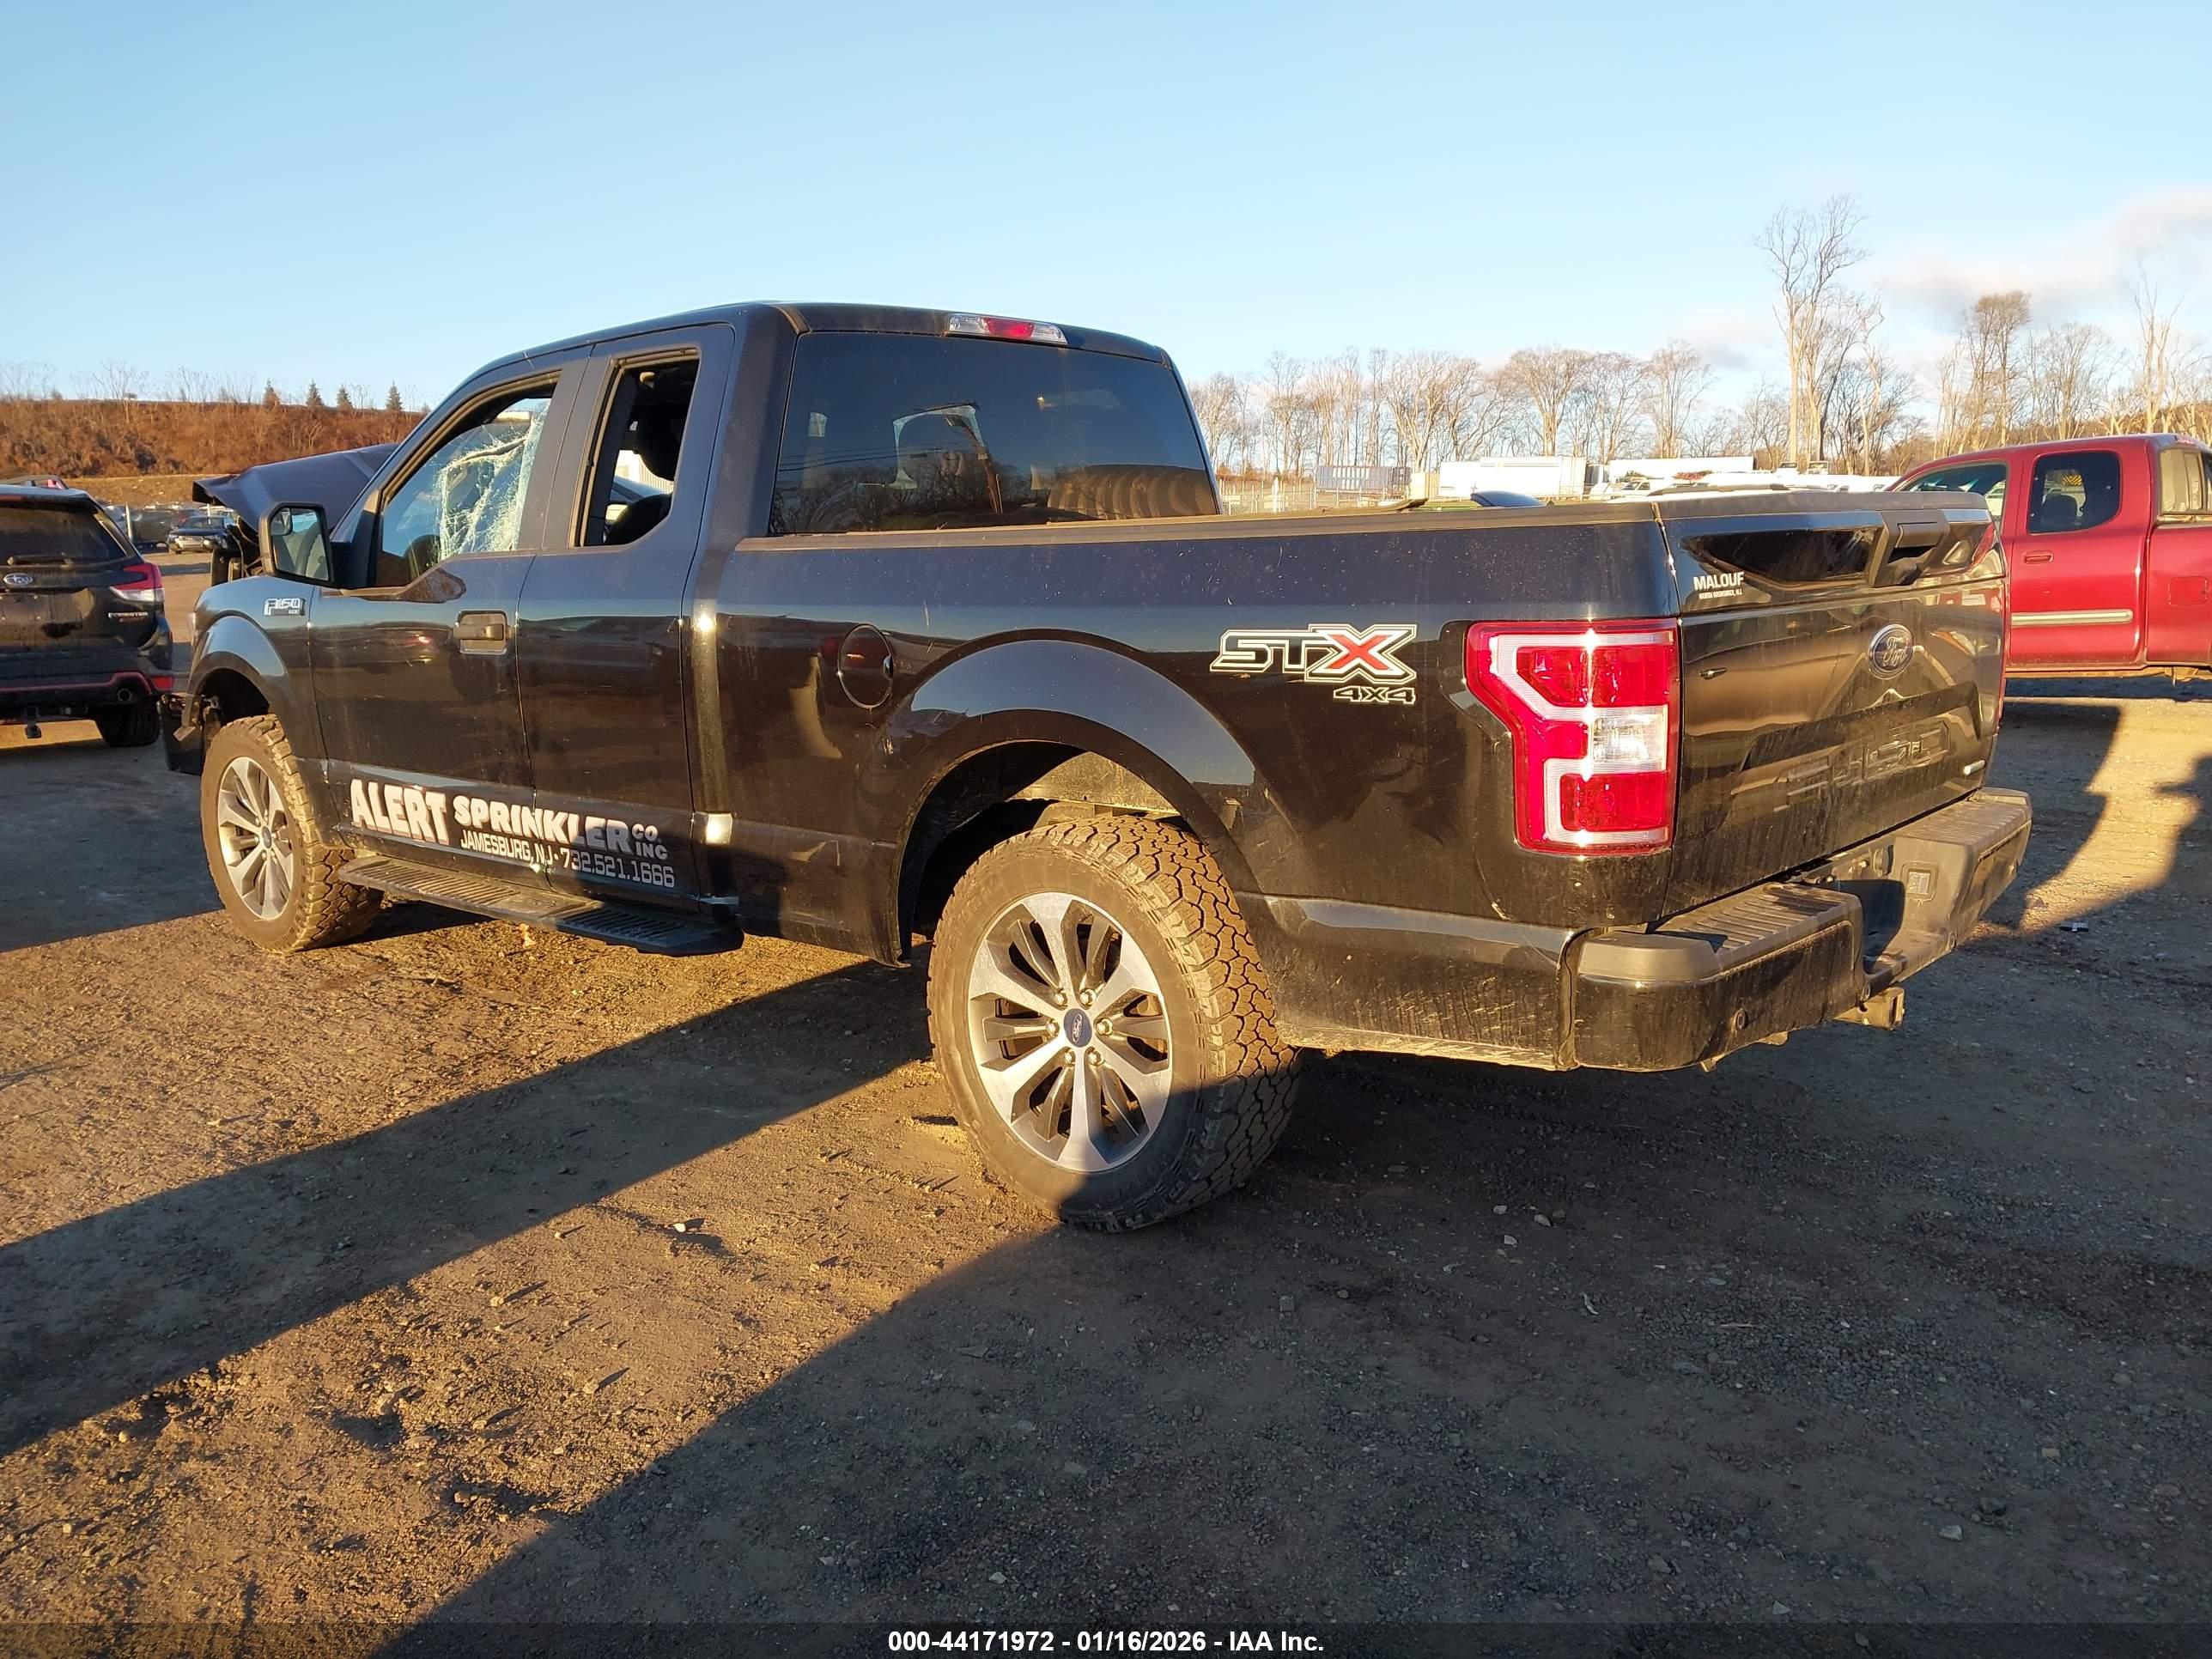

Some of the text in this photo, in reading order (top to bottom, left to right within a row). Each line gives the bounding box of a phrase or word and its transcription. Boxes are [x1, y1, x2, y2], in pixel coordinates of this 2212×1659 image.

[1693, 571, 1744, 591] MALOUF
[1210, 623, 1417, 684] STX
[350, 778, 449, 846] ALERT
[453, 795, 633, 855] SPRINKLER
[460, 830, 533, 866] JAMESBURG,
[560, 847, 675, 888] 732.521.1666
[635, 842, 669, 860] INC
